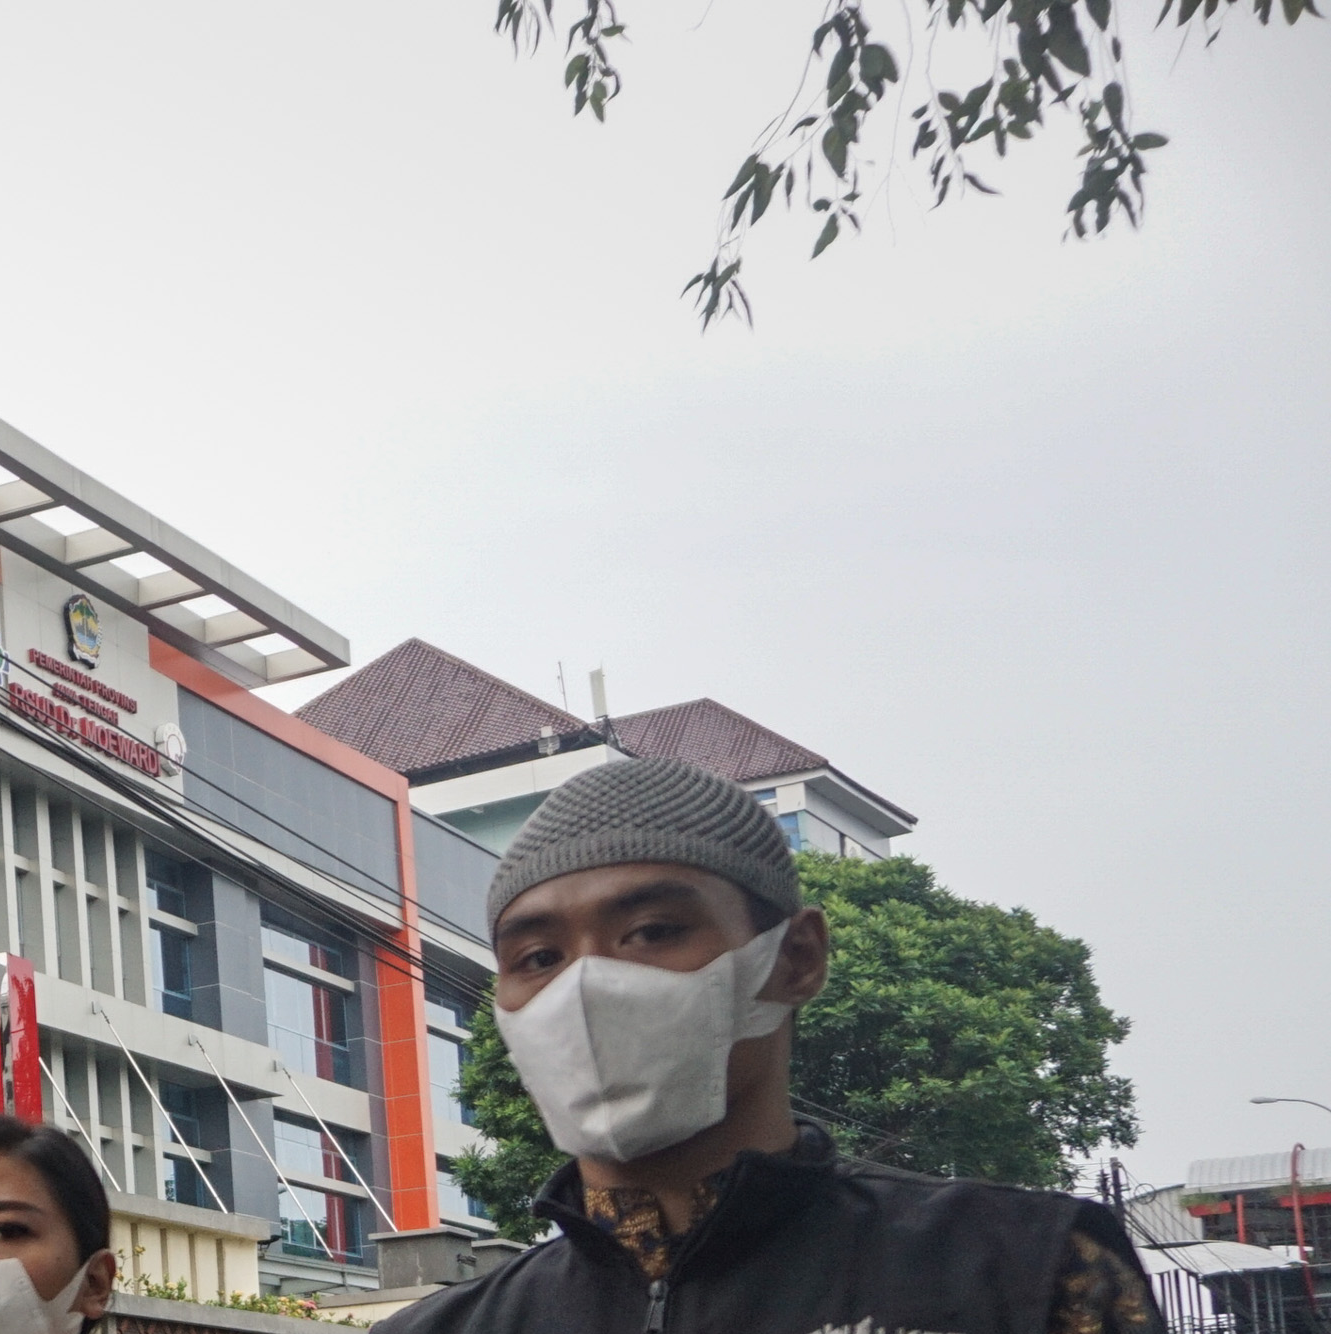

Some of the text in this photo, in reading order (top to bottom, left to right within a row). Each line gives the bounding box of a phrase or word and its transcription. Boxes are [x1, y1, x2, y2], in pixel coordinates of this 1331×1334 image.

[9, 682, 57, 726] RSUD
[28, 648, 137, 714] PEMERINTAH PROVINSI
